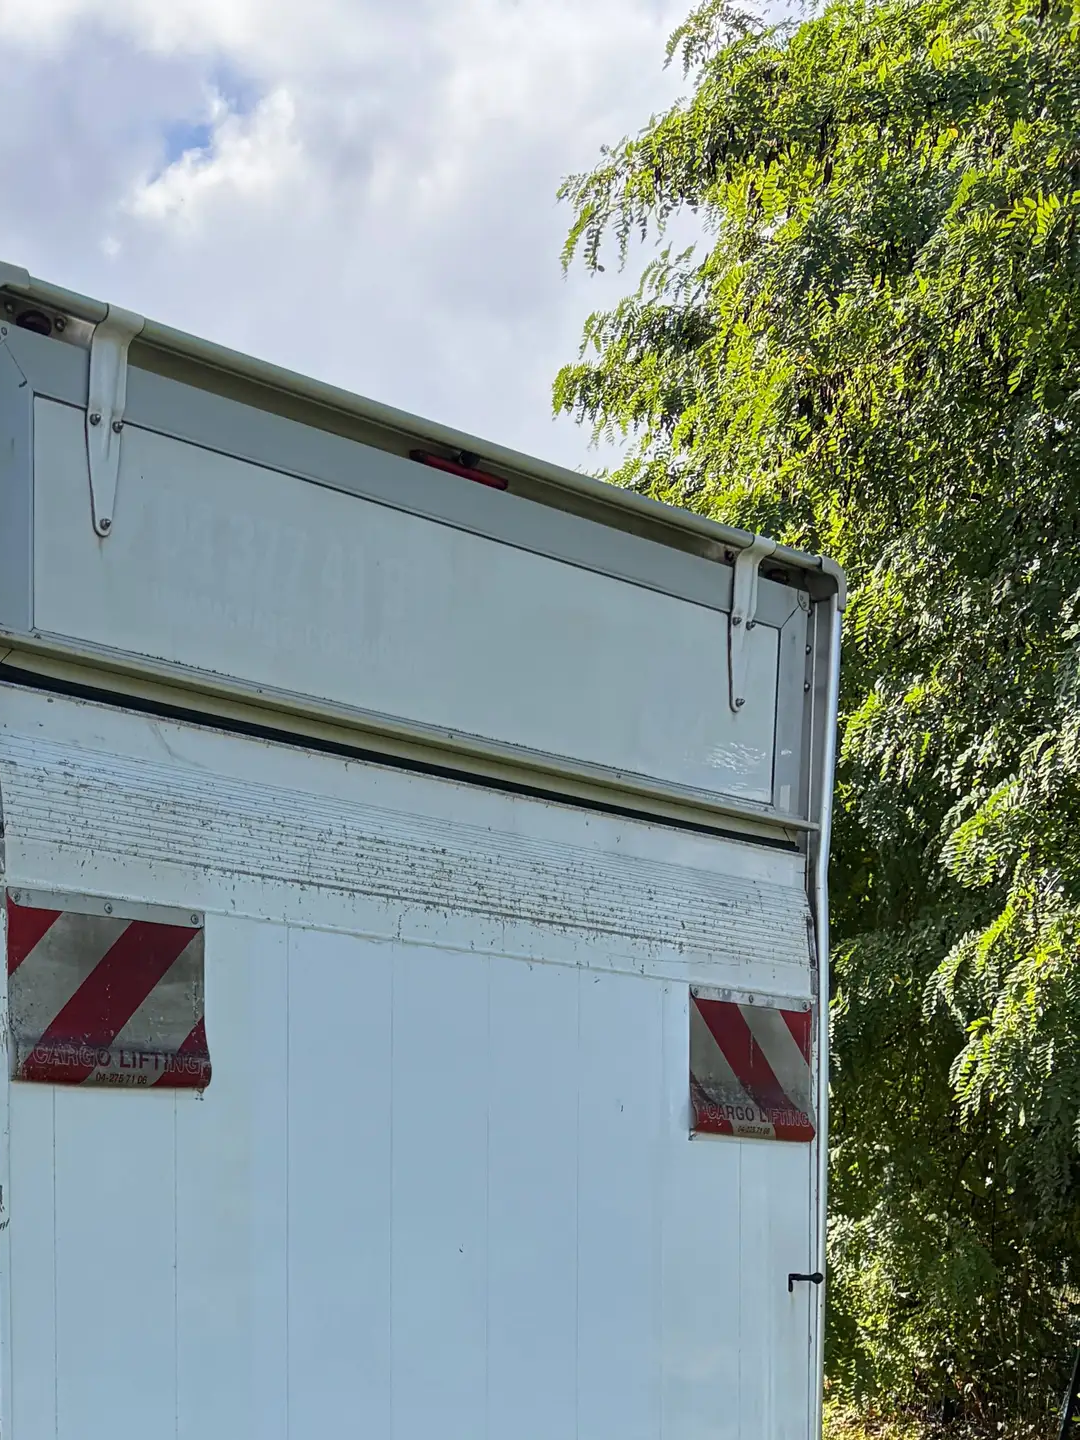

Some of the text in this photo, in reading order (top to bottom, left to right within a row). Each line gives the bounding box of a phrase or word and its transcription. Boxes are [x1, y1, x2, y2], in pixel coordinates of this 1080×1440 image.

[32, 1045, 203, 1075] CARGO LIFTING
[706, 1102, 810, 1127] CARGO LIFTING
